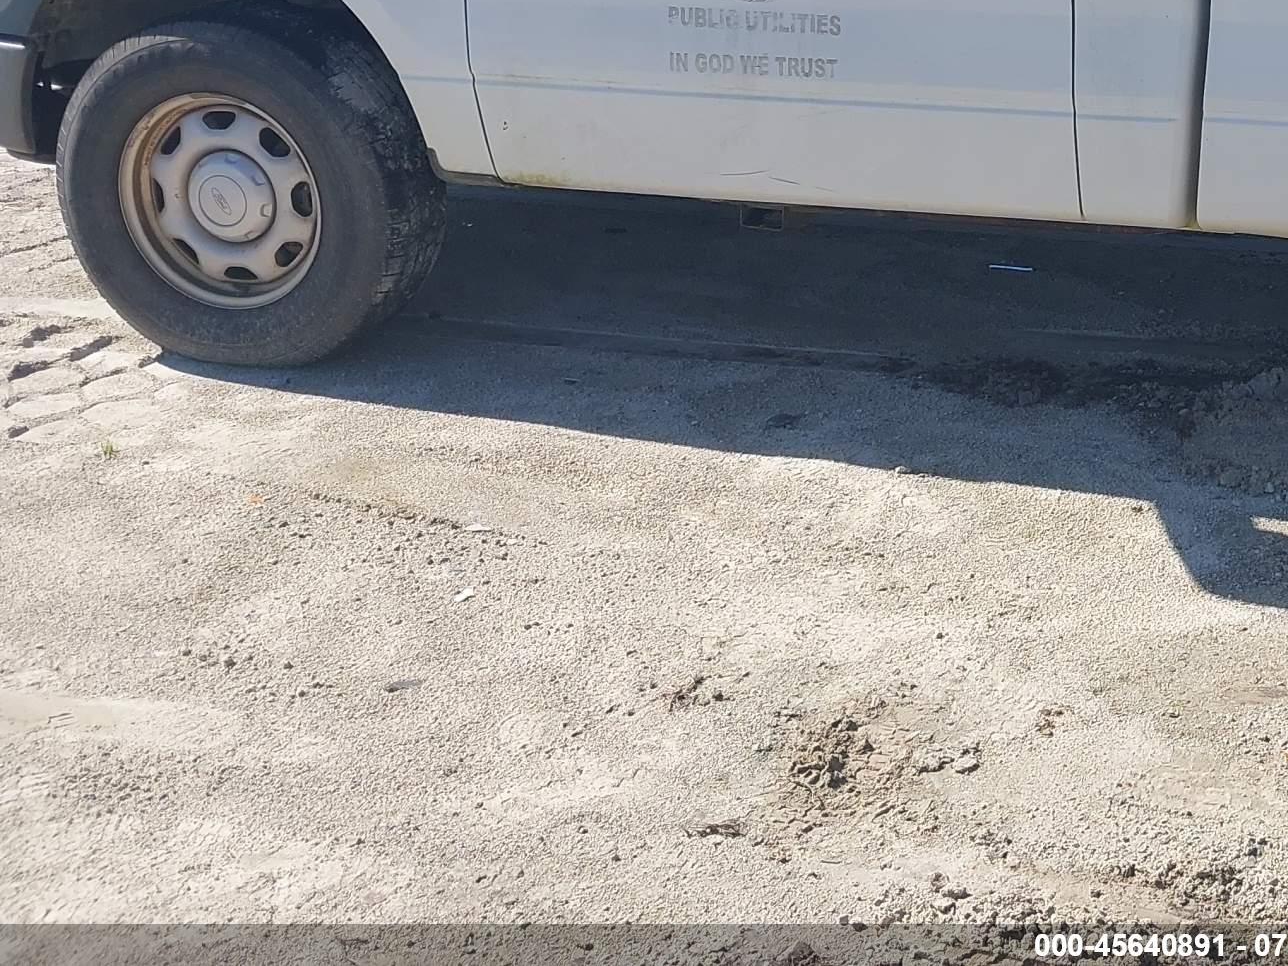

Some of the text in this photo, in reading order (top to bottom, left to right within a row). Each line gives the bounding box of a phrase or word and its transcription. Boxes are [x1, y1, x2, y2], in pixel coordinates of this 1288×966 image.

[667, 5, 842, 36] PUBLIC UTILITIES
[669, 51, 839, 79] IN GOD WE TRUST
